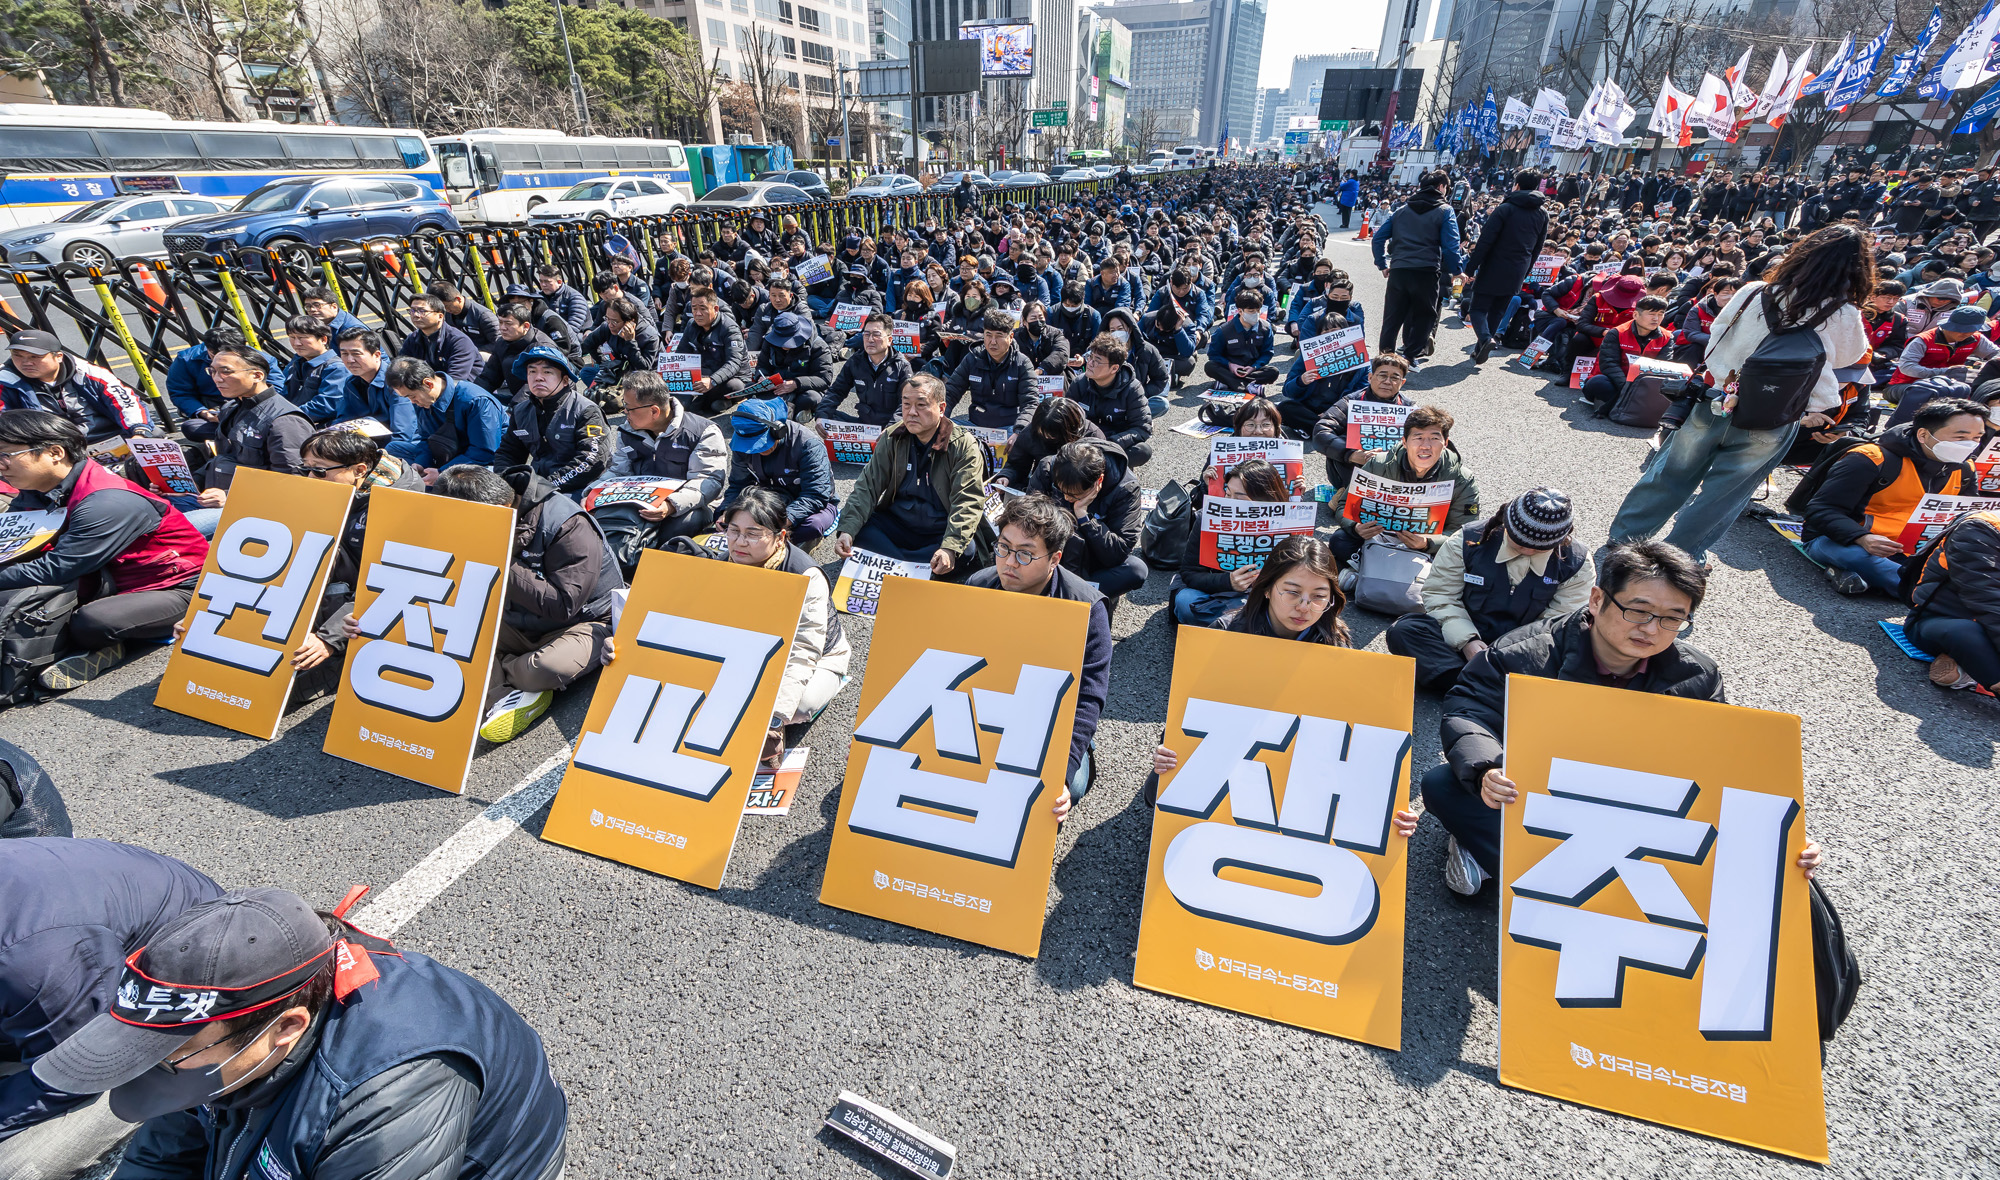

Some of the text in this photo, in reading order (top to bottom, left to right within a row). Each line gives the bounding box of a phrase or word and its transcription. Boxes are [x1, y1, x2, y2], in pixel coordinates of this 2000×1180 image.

[61, 182, 104, 198] 경찰
[524, 176, 541, 187] 경찰
[837, 315, 861, 323] 투쟁으로
[110, 305, 154, 387] POLICE LINE
[892, 335, 913, 345] 쟁으로
[892, 344, 918, 354] 취하자!
[1303, 330, 1346, 351] 모든 노동자의
[667, 354, 687, 363] 노동자의
[1306, 341, 1340, 359] 노동기본권
[1314, 344, 1357, 367] 투쟁으로
[1317, 354, 1365, 377] 쟁취하자!
[1351, 404, 1407, 416] 모든 노동자의
[824, 422, 865, 434] 모든 노동자의
[1353, 415, 1396, 425] 노동기본권
[826, 432, 859, 441] 노동기본권
[1359, 423, 1405, 439] 투쟁으
[133, 443, 155, 454] 모든
[833, 441, 872, 453] 투쟁으로
[1214, 440, 1279, 453] 모든 노동자의
[1360, 437, 1398, 452] 쟁취하
[1216, 452, 1267, 464] 노동기본권
[157, 464, 190, 479] 투쟁으
[552, 461, 590, 487] GEOGRAPHI
[1354, 473, 1427, 495] 모든 노동자의
[1355, 486, 1410, 505] 노동기본권
[1921, 498, 1953, 512] 모든
[1207, 501, 1286, 519] 모든 노동자의
[1360, 498, 1430, 520] 투쟁으로
[1209, 518, 1270, 532] 노동기본권
[849, 550, 895, 571] 진짜사장
[1217, 552, 1270, 572] 쟁취하
[182, 517, 335, 677] 원
[851, 580, 882, 599] 원청
[846, 596, 879, 615] 쟁취
[350, 540, 501, 722] 청
[196, 684, 252, 710] 전국금속노동조합
[574, 611, 784, 803] 교
[370, 731, 435, 760] 전국금속노동조합
[848, 648, 1075, 868] 섭
[751, 773, 776, 790] 로
[747, 789, 786, 808] 자!
[1155, 697, 1412, 945] 쟁
[605, 814, 687, 850] 전국금속노동조합
[891, 876, 993, 914] 전국금속노동조합
[1508, 757, 1801, 1041] 취
[1218, 955, 1340, 998] 전국금속노동조합
[138, 985, 218, 1022] 투쟁
[1597, 1050, 1748, 1104] 전국금속노동조합
[843, 1109, 940, 1174] 김승섭 조합원 질병판정위원
[886, 1149, 920, 1171] 반대한다
